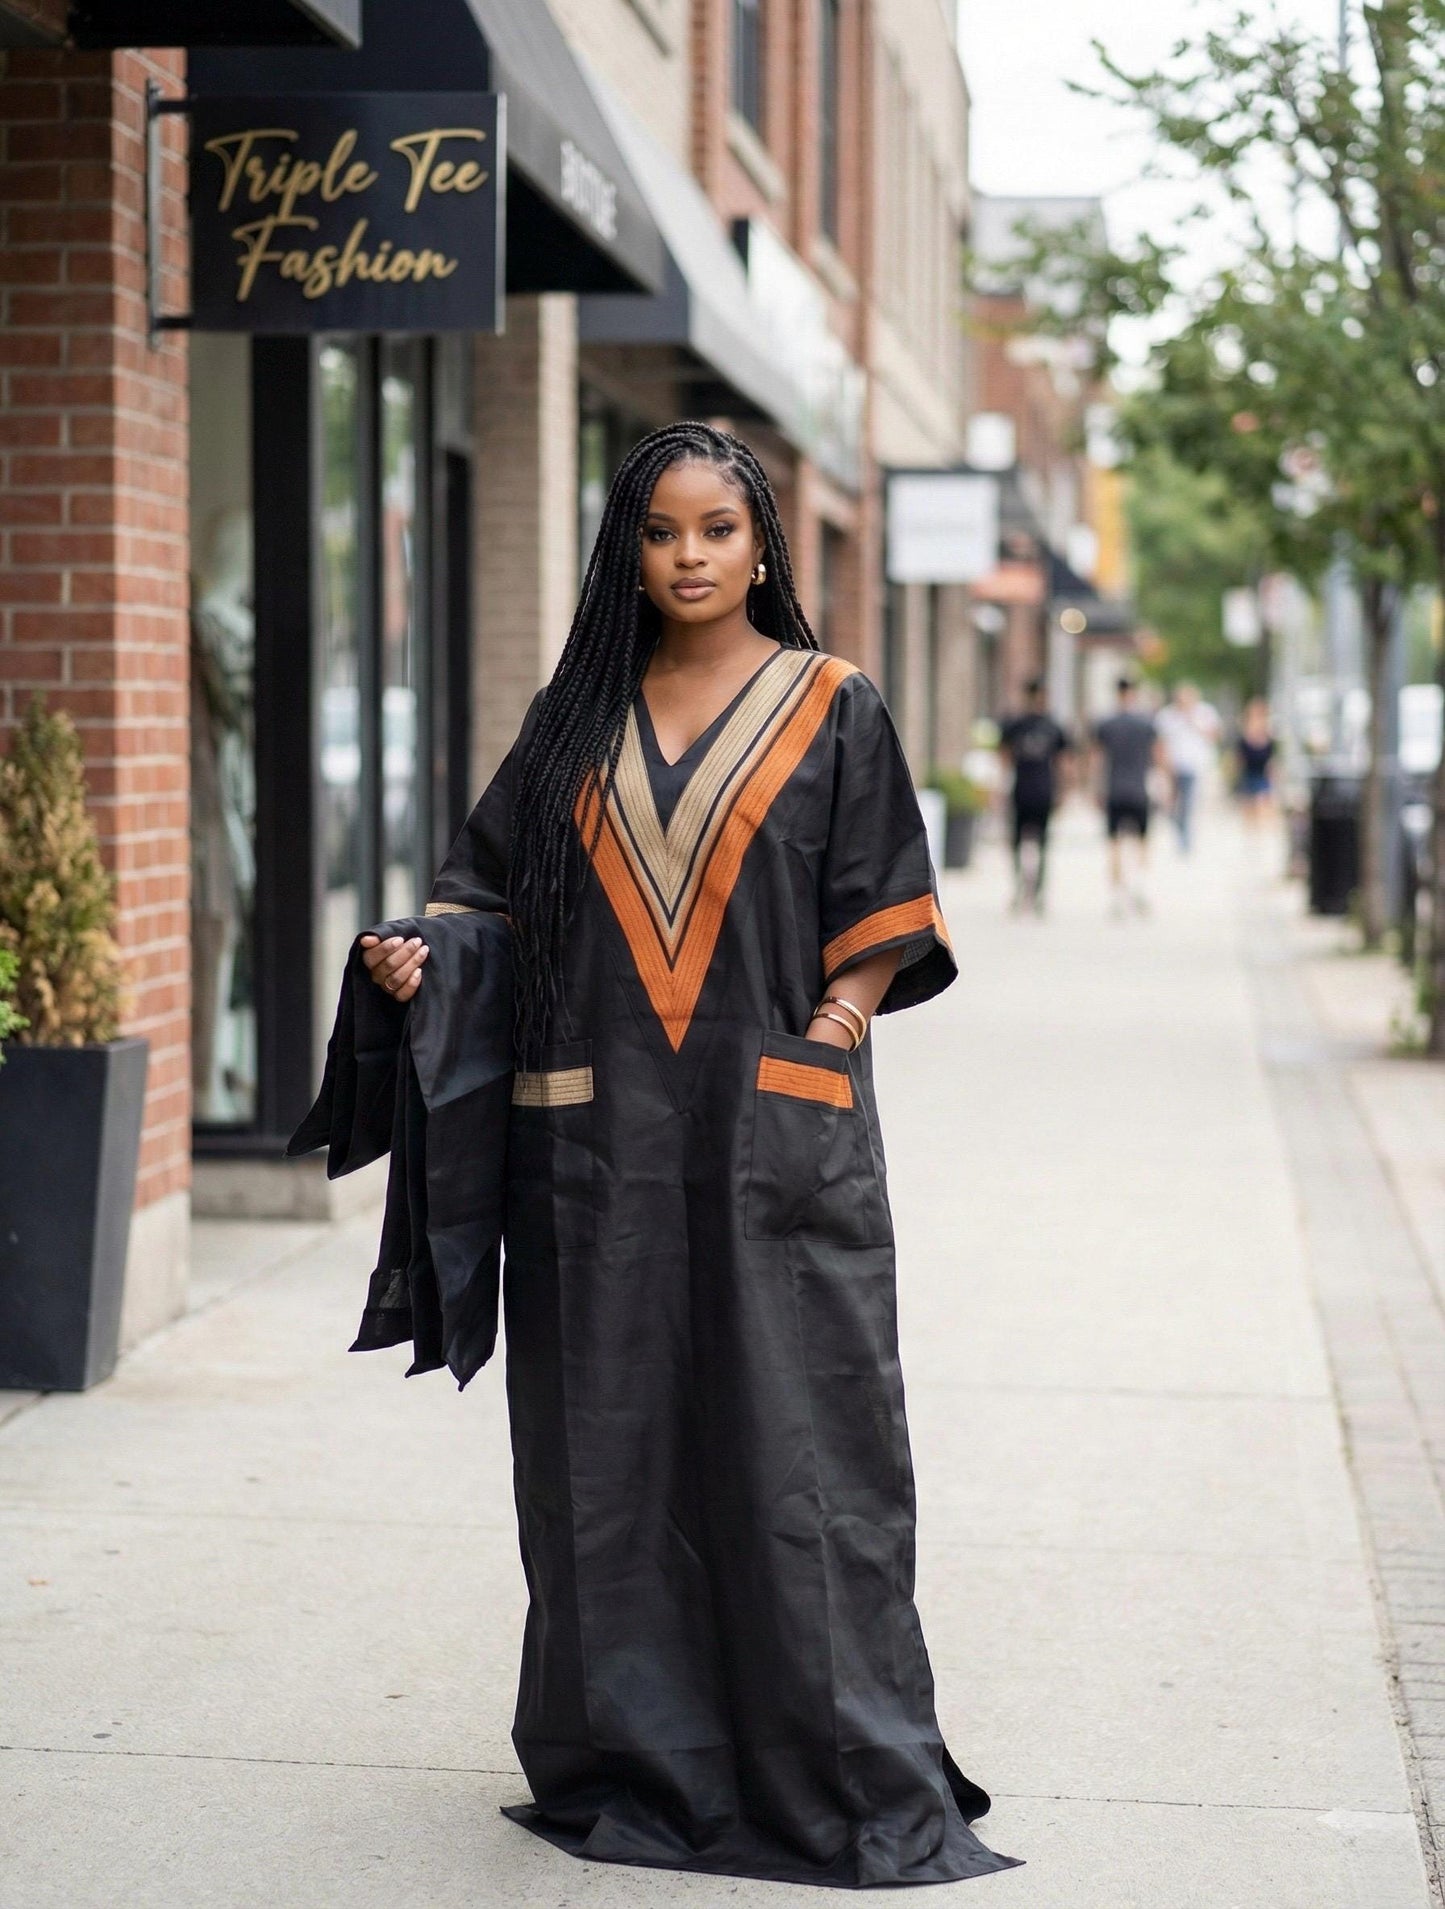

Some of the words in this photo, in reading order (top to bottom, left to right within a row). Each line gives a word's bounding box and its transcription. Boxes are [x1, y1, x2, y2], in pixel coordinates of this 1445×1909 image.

[205, 129, 378, 222] Triple
[391, 128, 488, 212] Tee
[233, 216, 457, 301] Fashion
